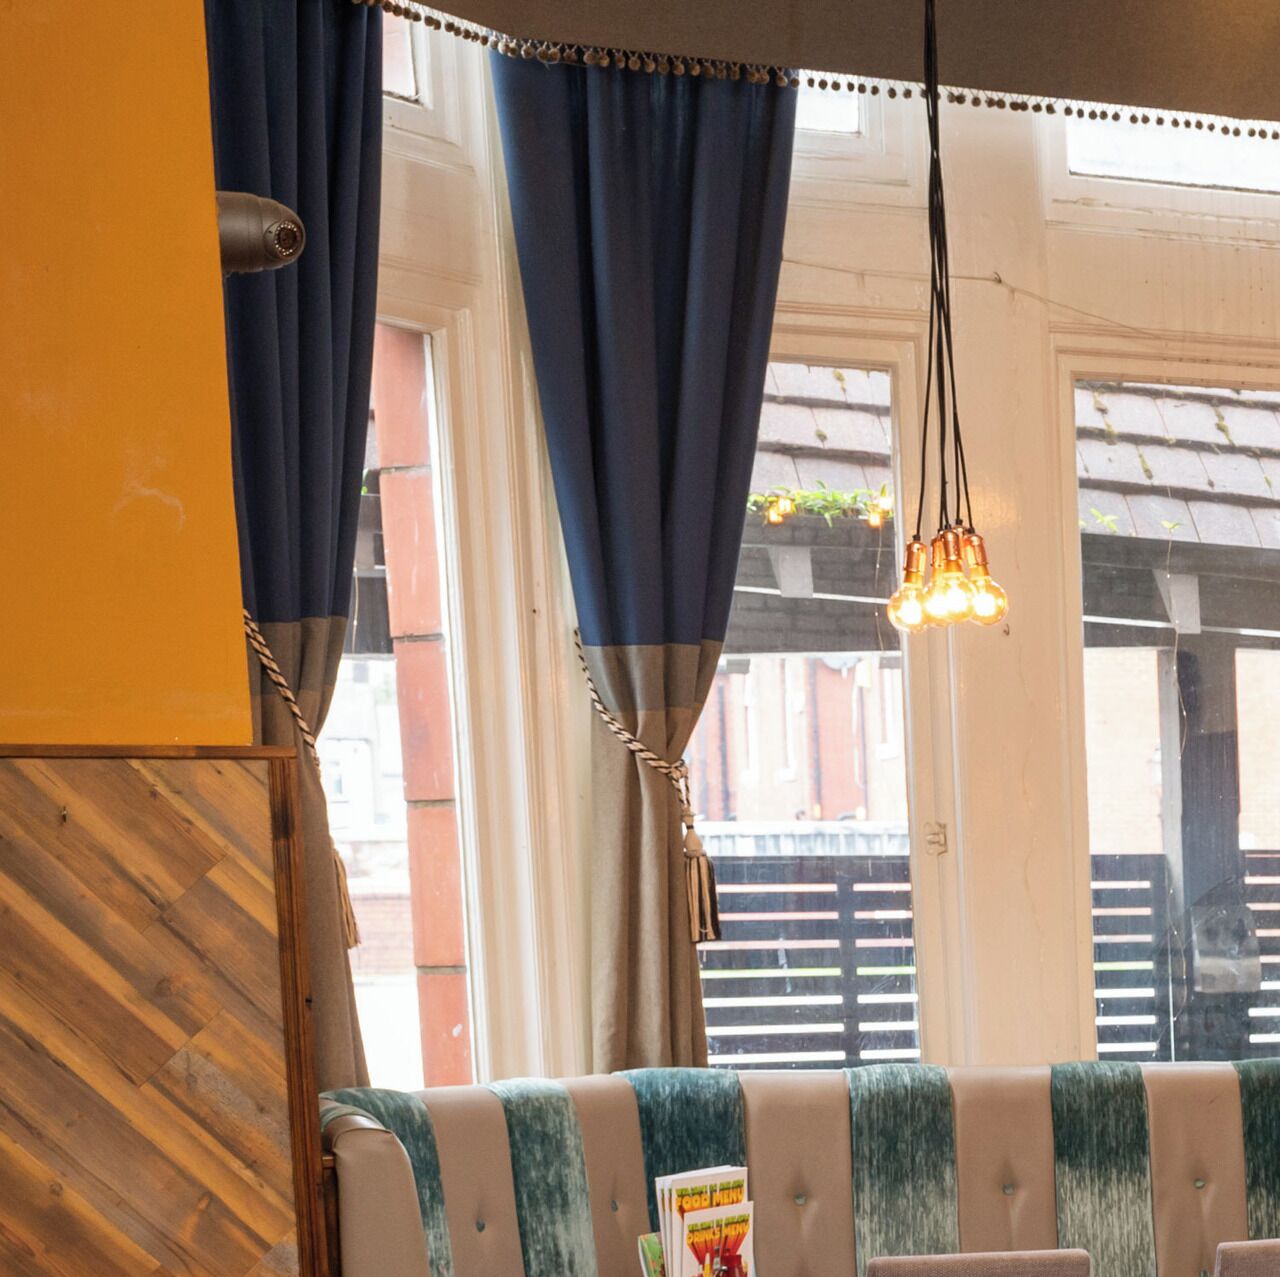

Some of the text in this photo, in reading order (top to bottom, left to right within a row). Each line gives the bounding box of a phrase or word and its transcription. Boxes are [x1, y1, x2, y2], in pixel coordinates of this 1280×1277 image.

[675, 1194, 709, 1212] FOOD
[713, 1187, 744, 1206] MENU
[687, 1222, 749, 1243] DRINKS MENU
